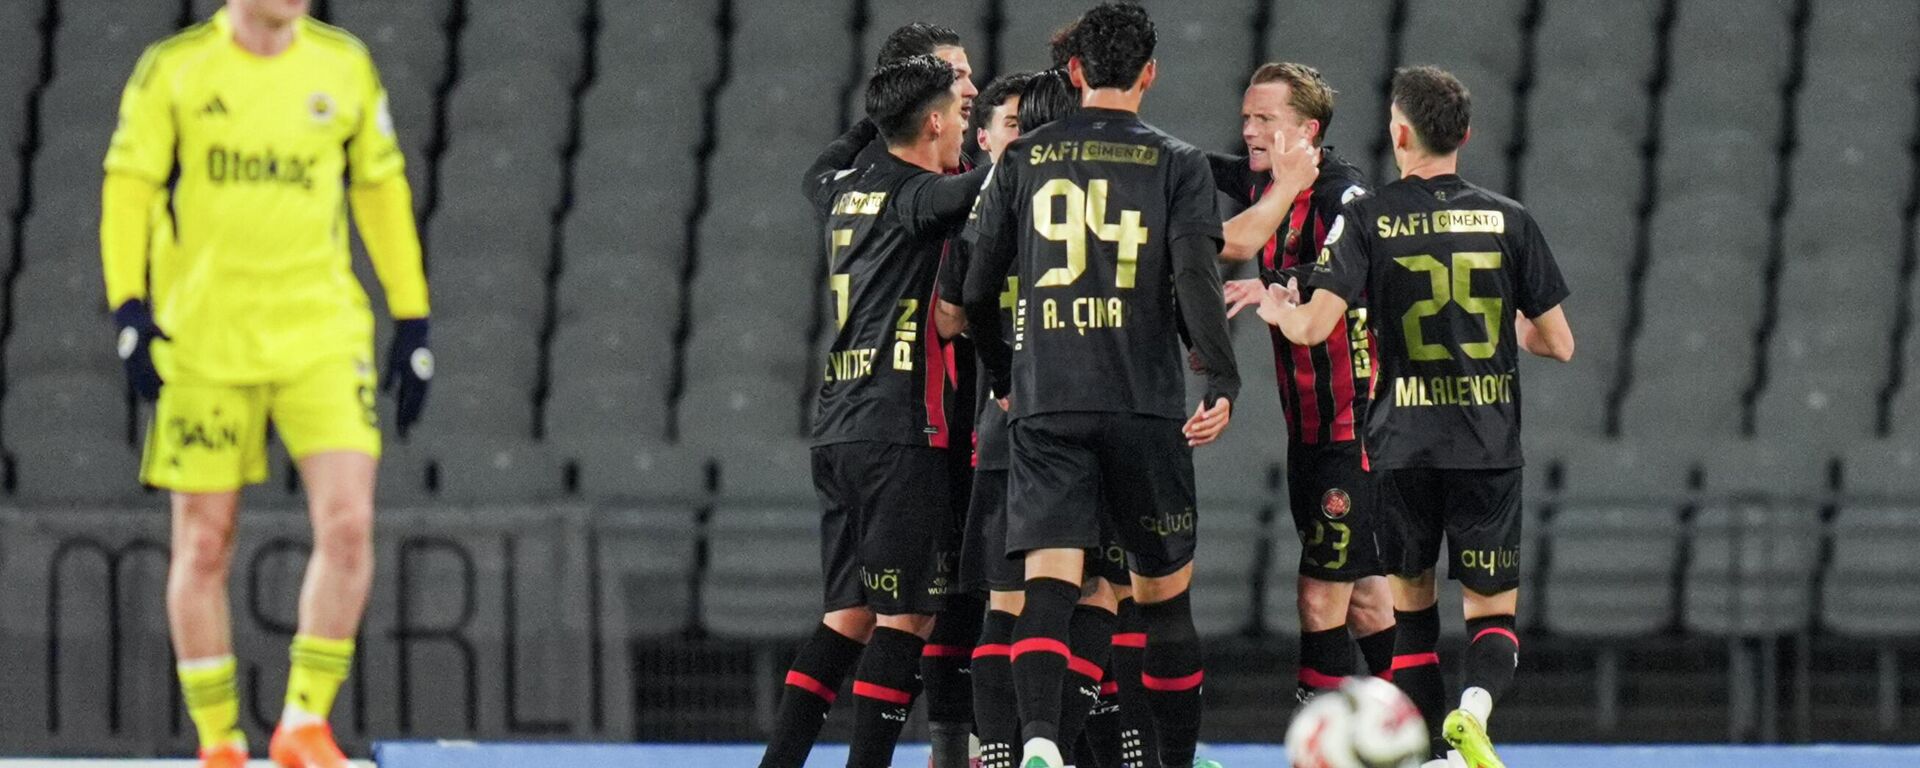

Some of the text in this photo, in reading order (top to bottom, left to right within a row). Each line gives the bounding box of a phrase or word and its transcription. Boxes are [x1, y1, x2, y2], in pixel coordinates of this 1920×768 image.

[1032, 179, 1148, 288] 94
[1043, 298, 1065, 329] A.
[1072, 297, 1123, 336] ÇINA
[1393, 252, 1503, 361] 25
